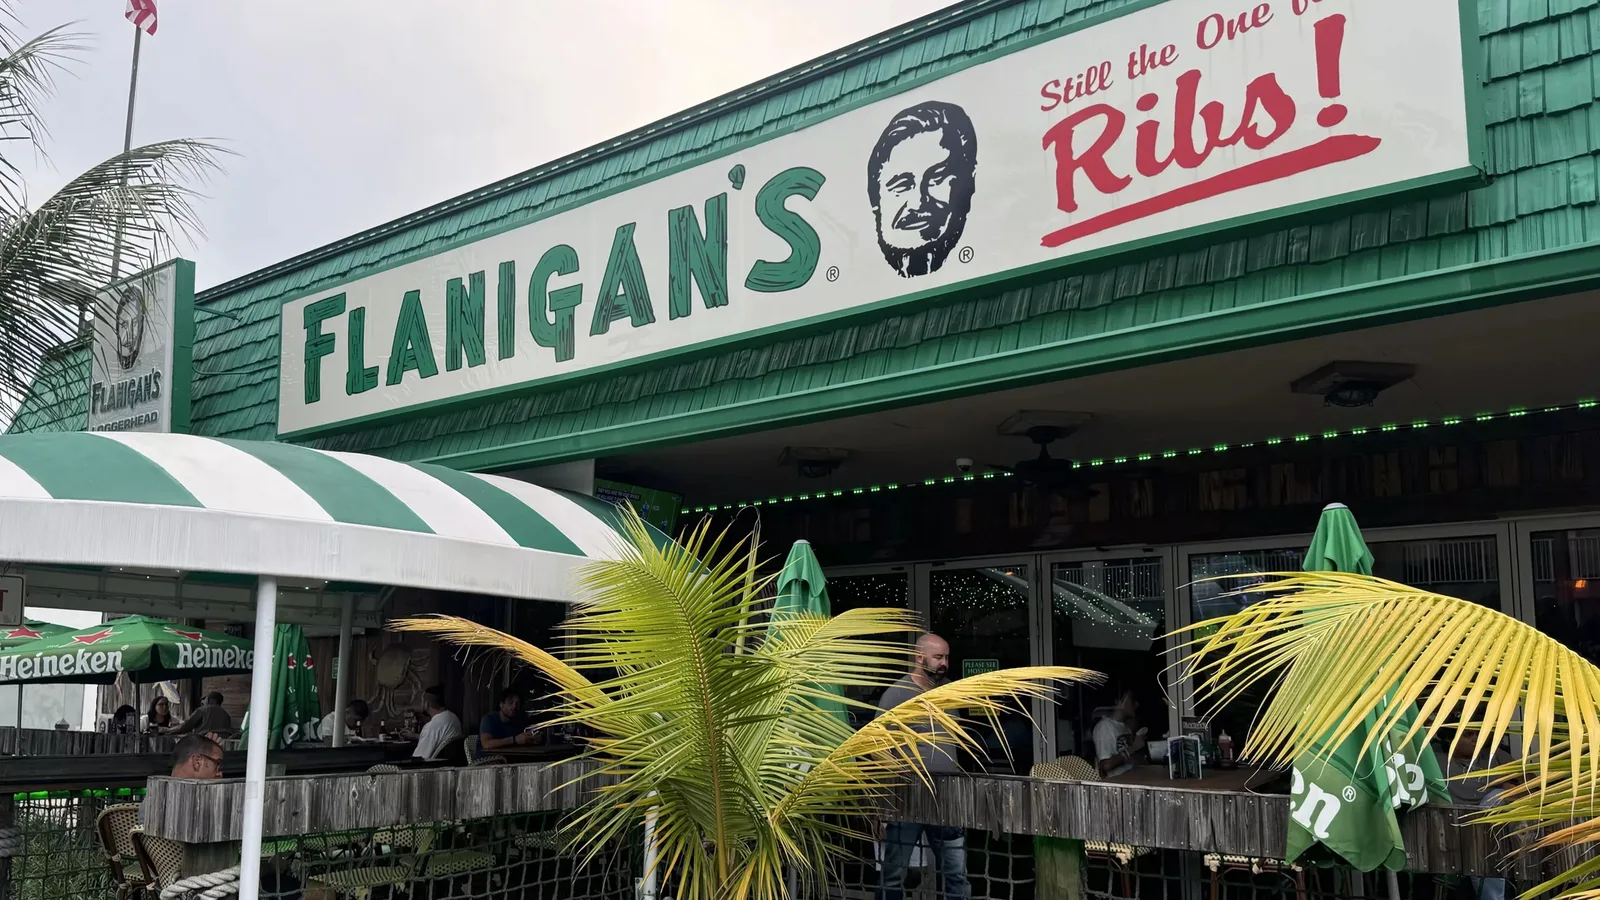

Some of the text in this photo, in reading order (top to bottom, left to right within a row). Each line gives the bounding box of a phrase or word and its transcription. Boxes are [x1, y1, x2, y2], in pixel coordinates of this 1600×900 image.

[1040, 2, 1274, 112] Still the One
[1042, 13, 1348, 213] Ribs!
[303, 163, 827, 405] FLANIGAN'S
[92, 367, 161, 414] FLANIGAN'S
[0, 648, 124, 680] Heineken
[175, 642, 254, 670] Heineke
